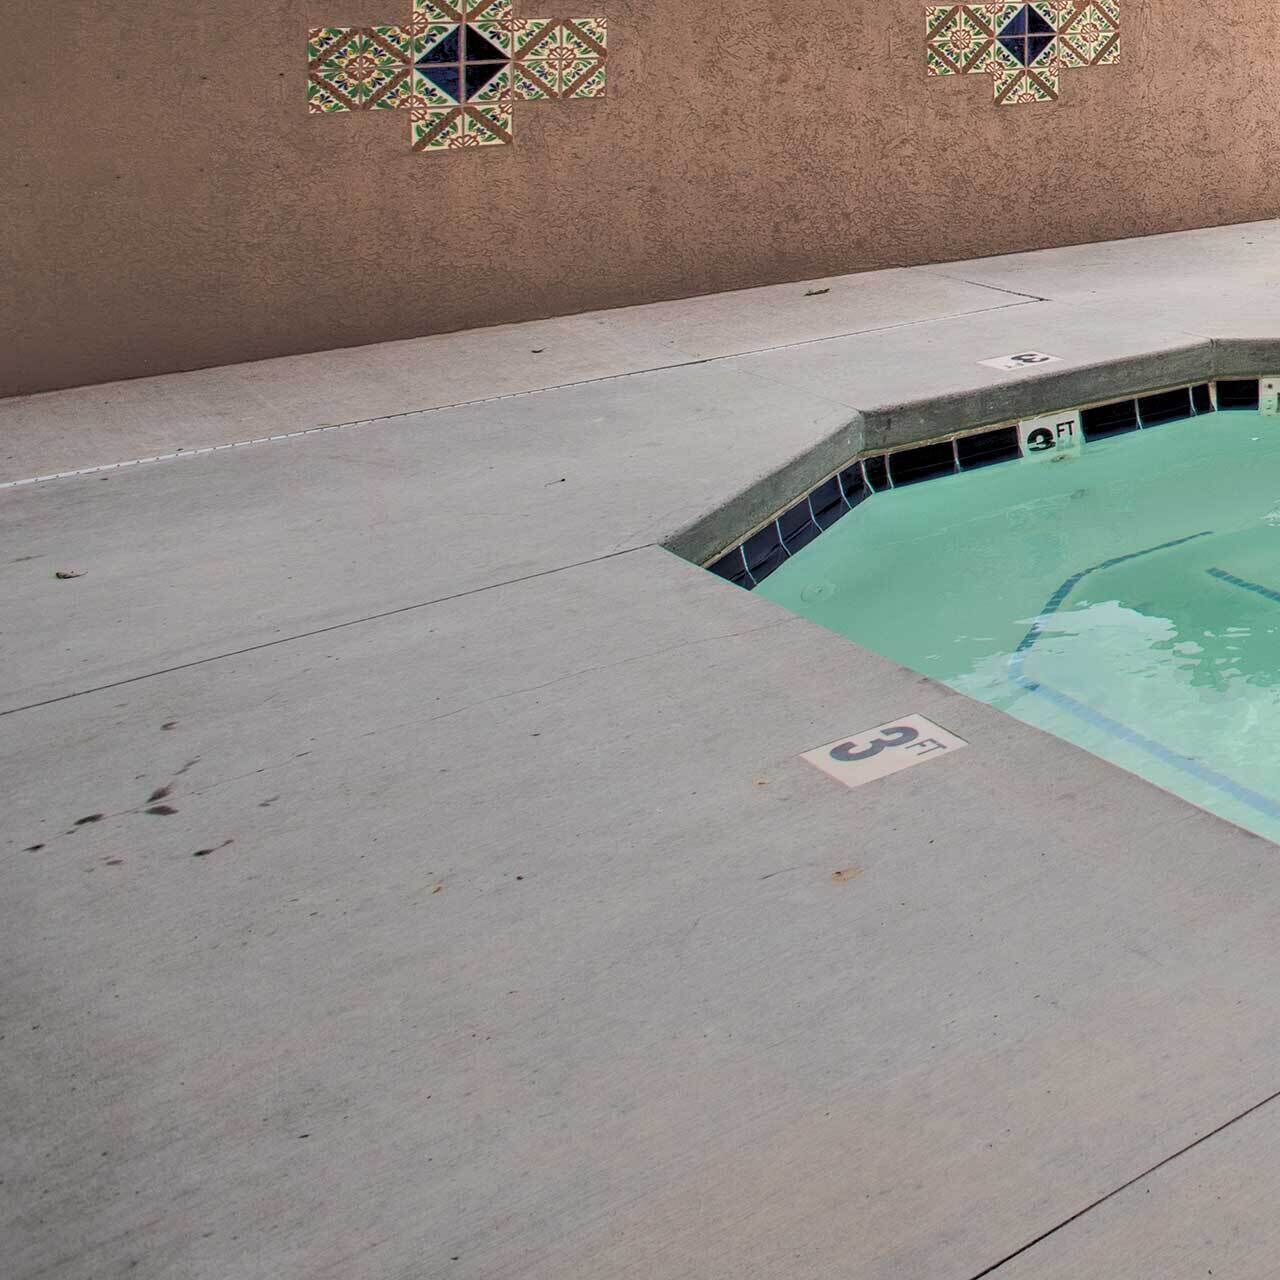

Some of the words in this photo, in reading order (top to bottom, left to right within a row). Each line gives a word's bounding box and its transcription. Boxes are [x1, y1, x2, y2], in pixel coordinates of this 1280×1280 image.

[1027, 427, 1057, 451] 3
[1056, 420, 1075, 438] FT
[829, 726, 919, 761] 3
[905, 738, 947, 756] FT
